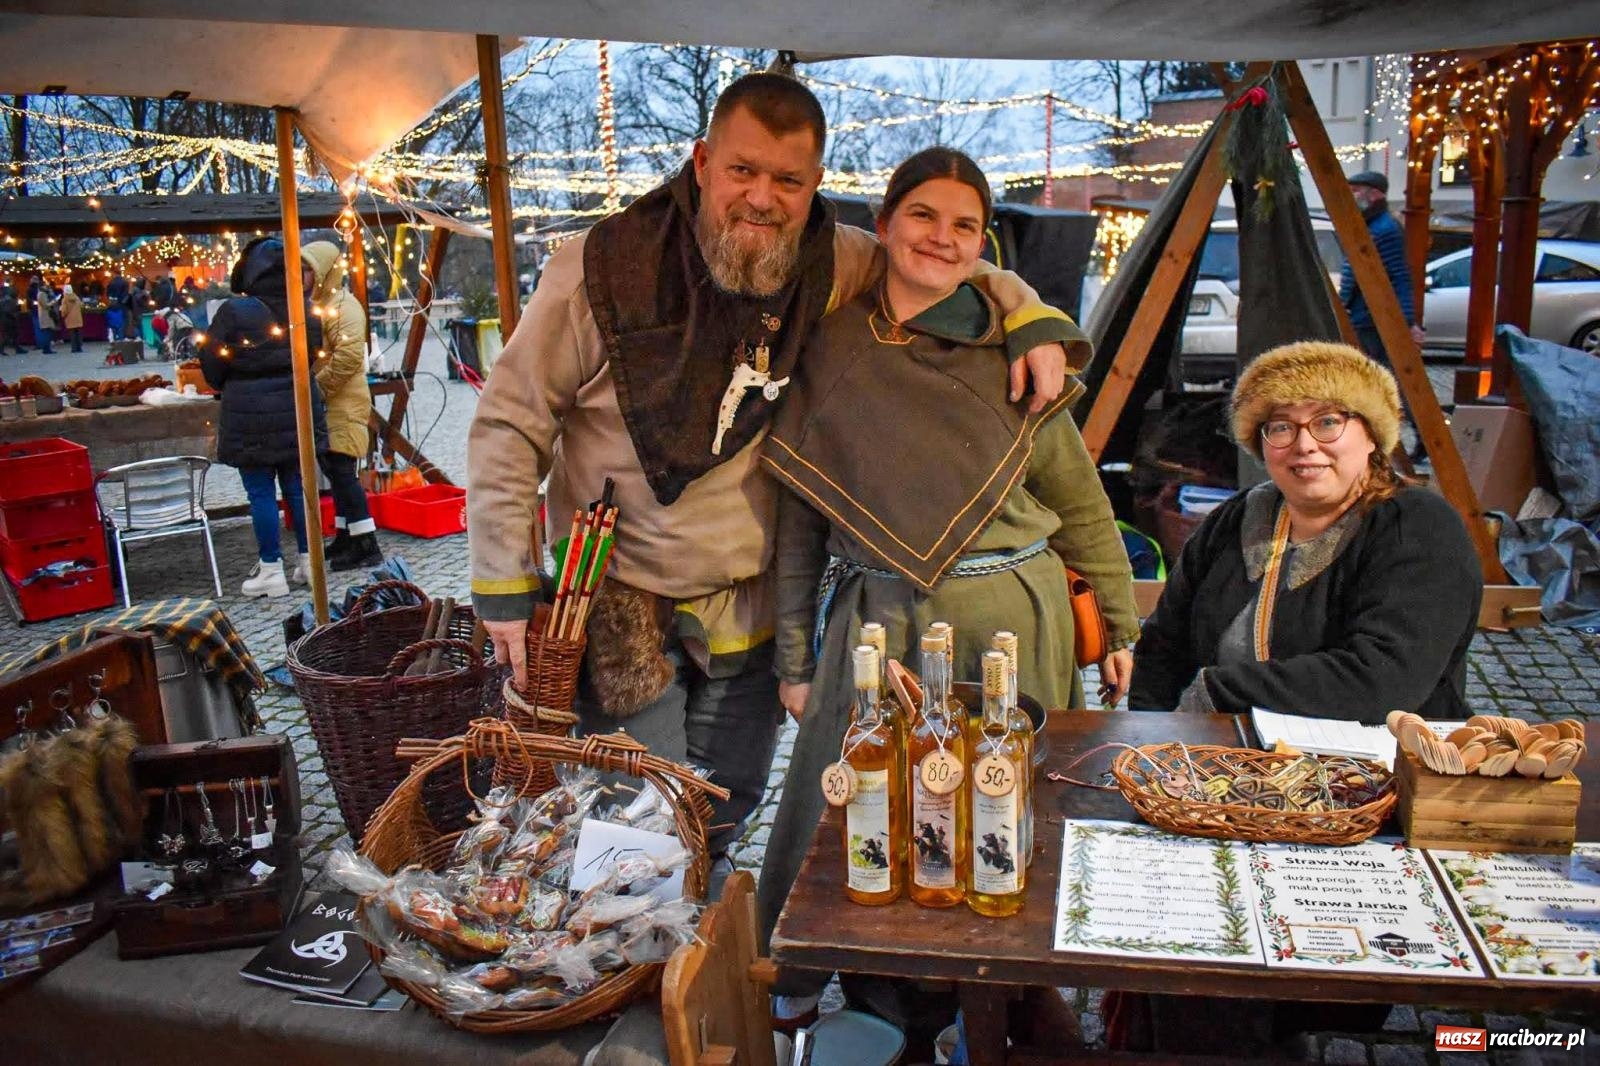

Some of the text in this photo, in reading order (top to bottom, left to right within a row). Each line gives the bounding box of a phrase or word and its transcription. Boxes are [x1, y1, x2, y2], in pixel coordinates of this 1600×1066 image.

[981, 765, 1010, 786] 50,-
[1303, 846, 1328, 855] nas
[1284, 857, 1386, 869] Strawa Woja
[1282, 874, 1313, 882] duża
[1316, 876, 1356, 885] porcja
[1288, 884, 1319, 892] mała
[1321, 886, 1363, 895] porcja
[1394, 888, 1408, 896] zł
[1294, 898, 1408, 911] Strawa Jarska
[1314, 915, 1359, 925] porcja
